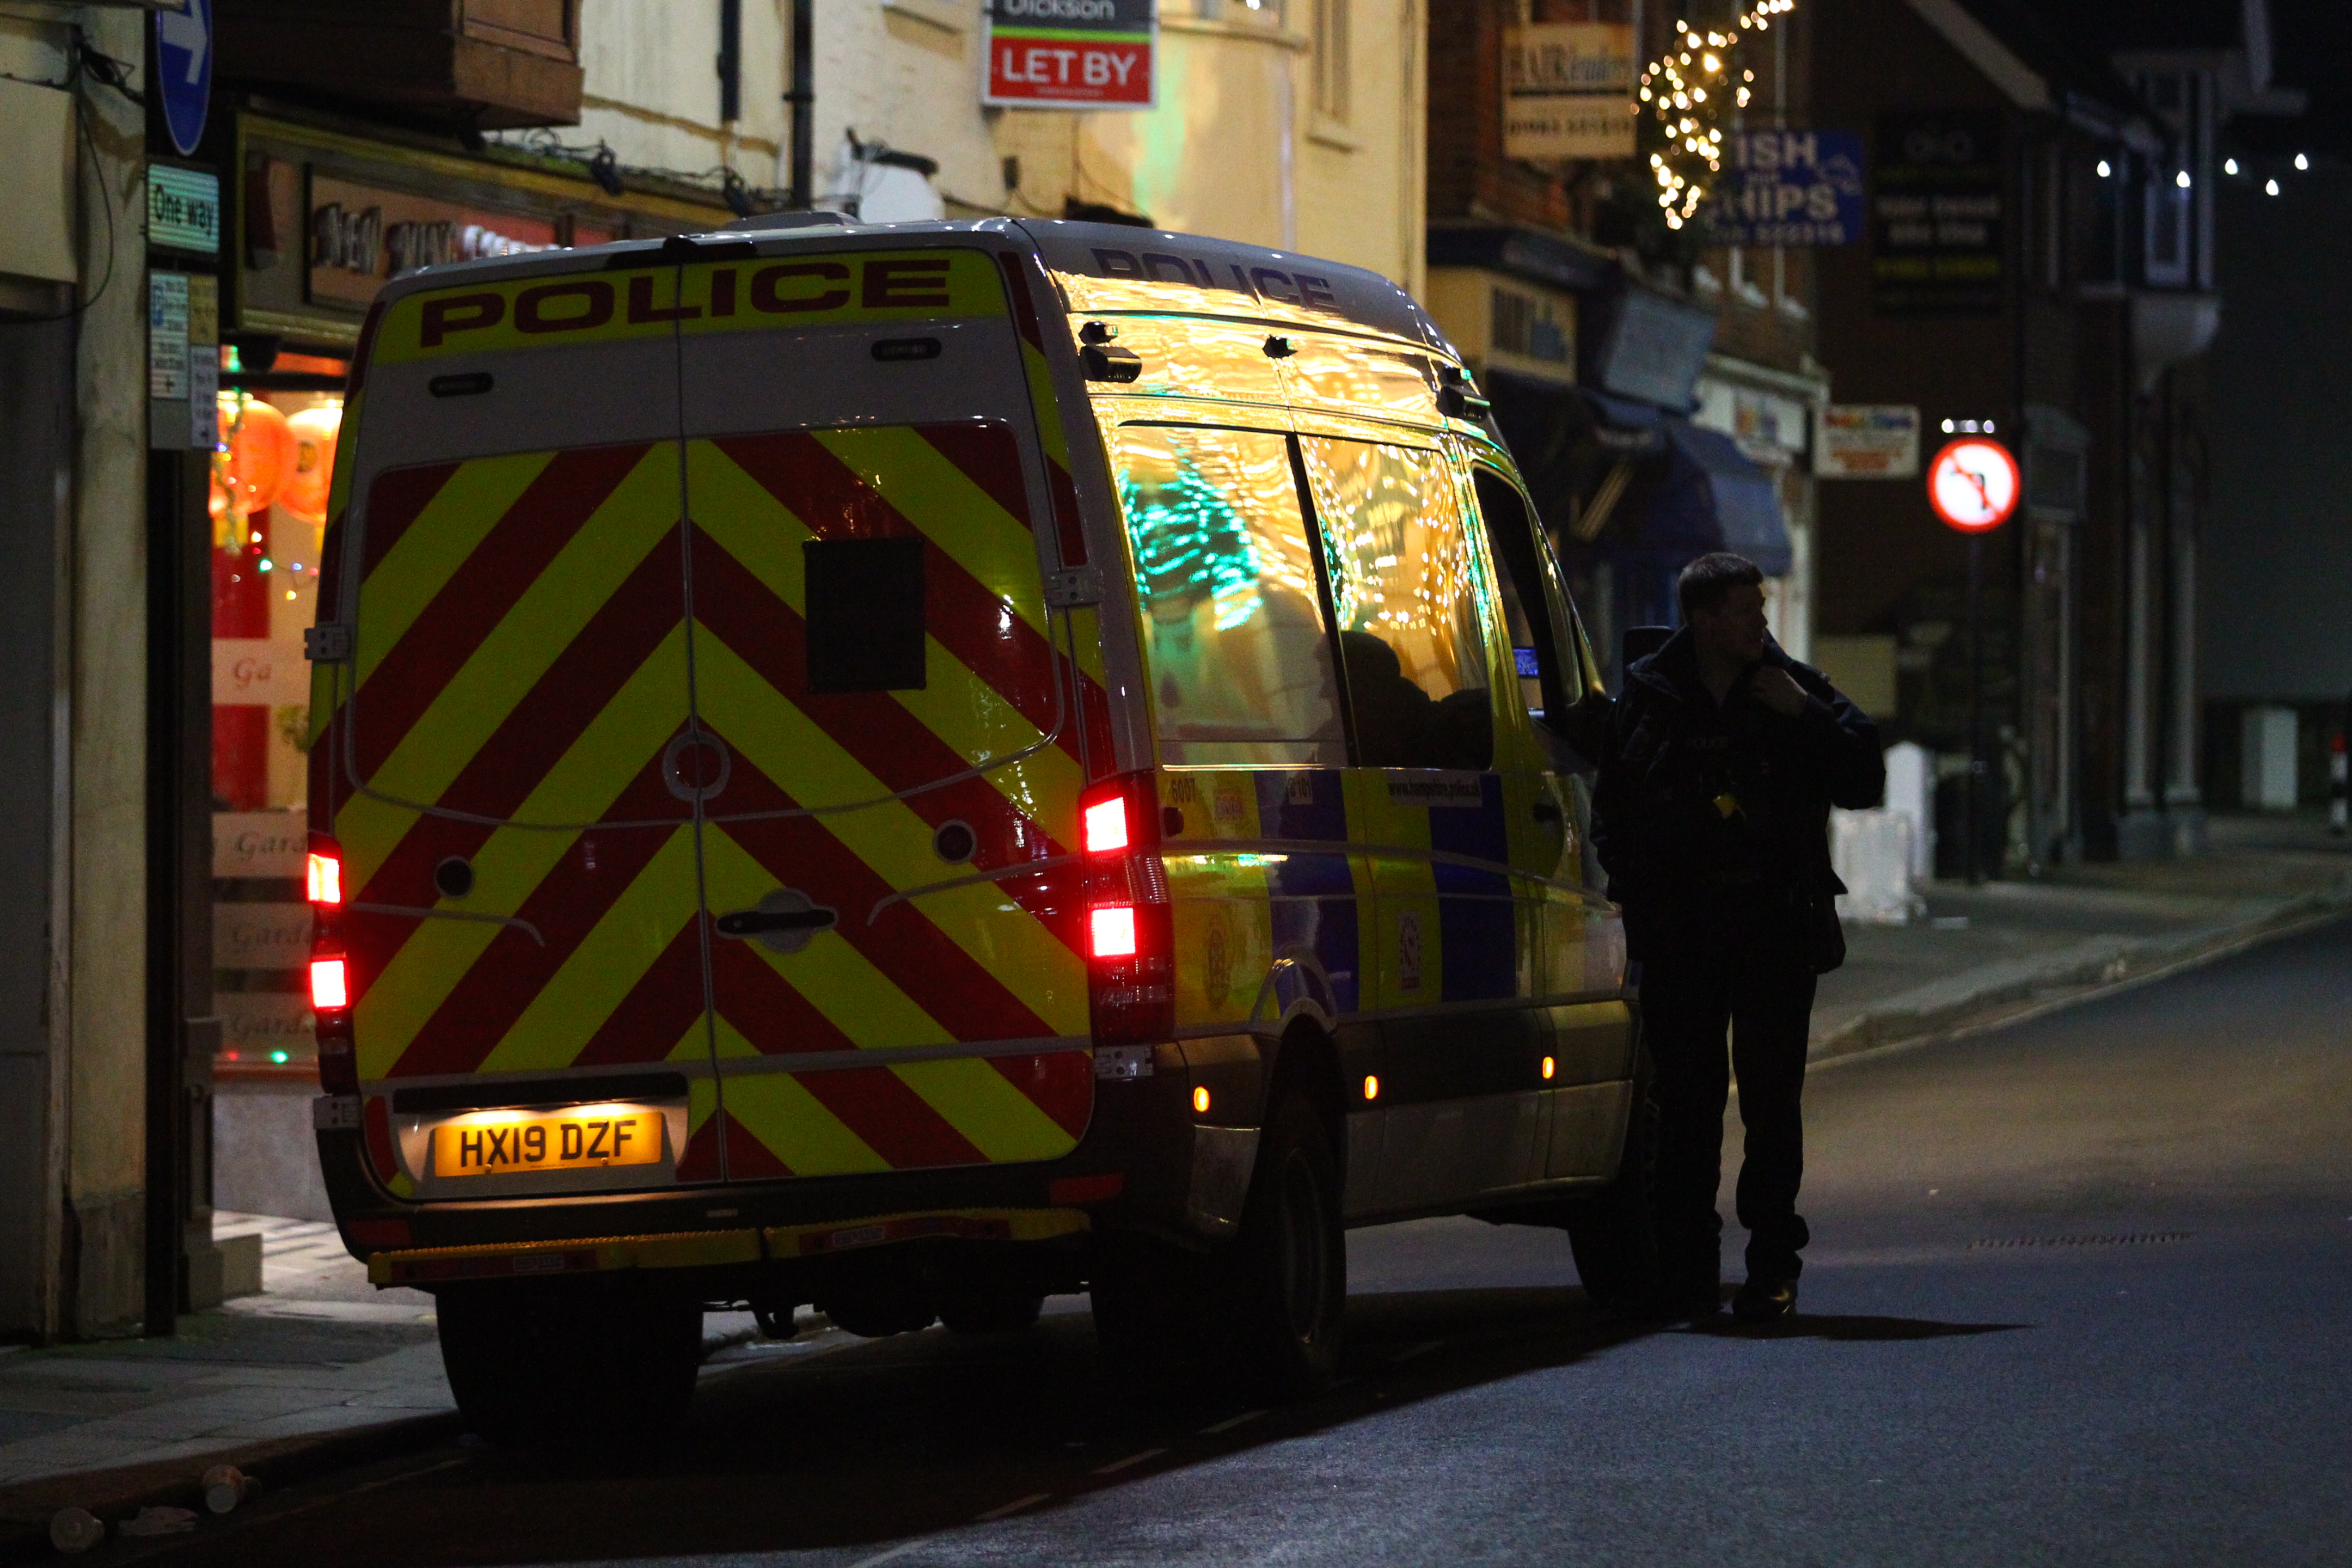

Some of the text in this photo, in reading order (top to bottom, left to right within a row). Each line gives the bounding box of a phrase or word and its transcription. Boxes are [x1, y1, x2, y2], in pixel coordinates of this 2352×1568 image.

[1002, 47, 1137, 87] LET BY
[1736, 132, 1817, 167] ISH
[156, 184, 213, 236] One way
[1723, 184, 1838, 220] HIPS
[421, 259, 950, 348] POLICE
[1091, 248, 1340, 313] POLICE
[461, 1120, 636, 1167] HX19 DZF
